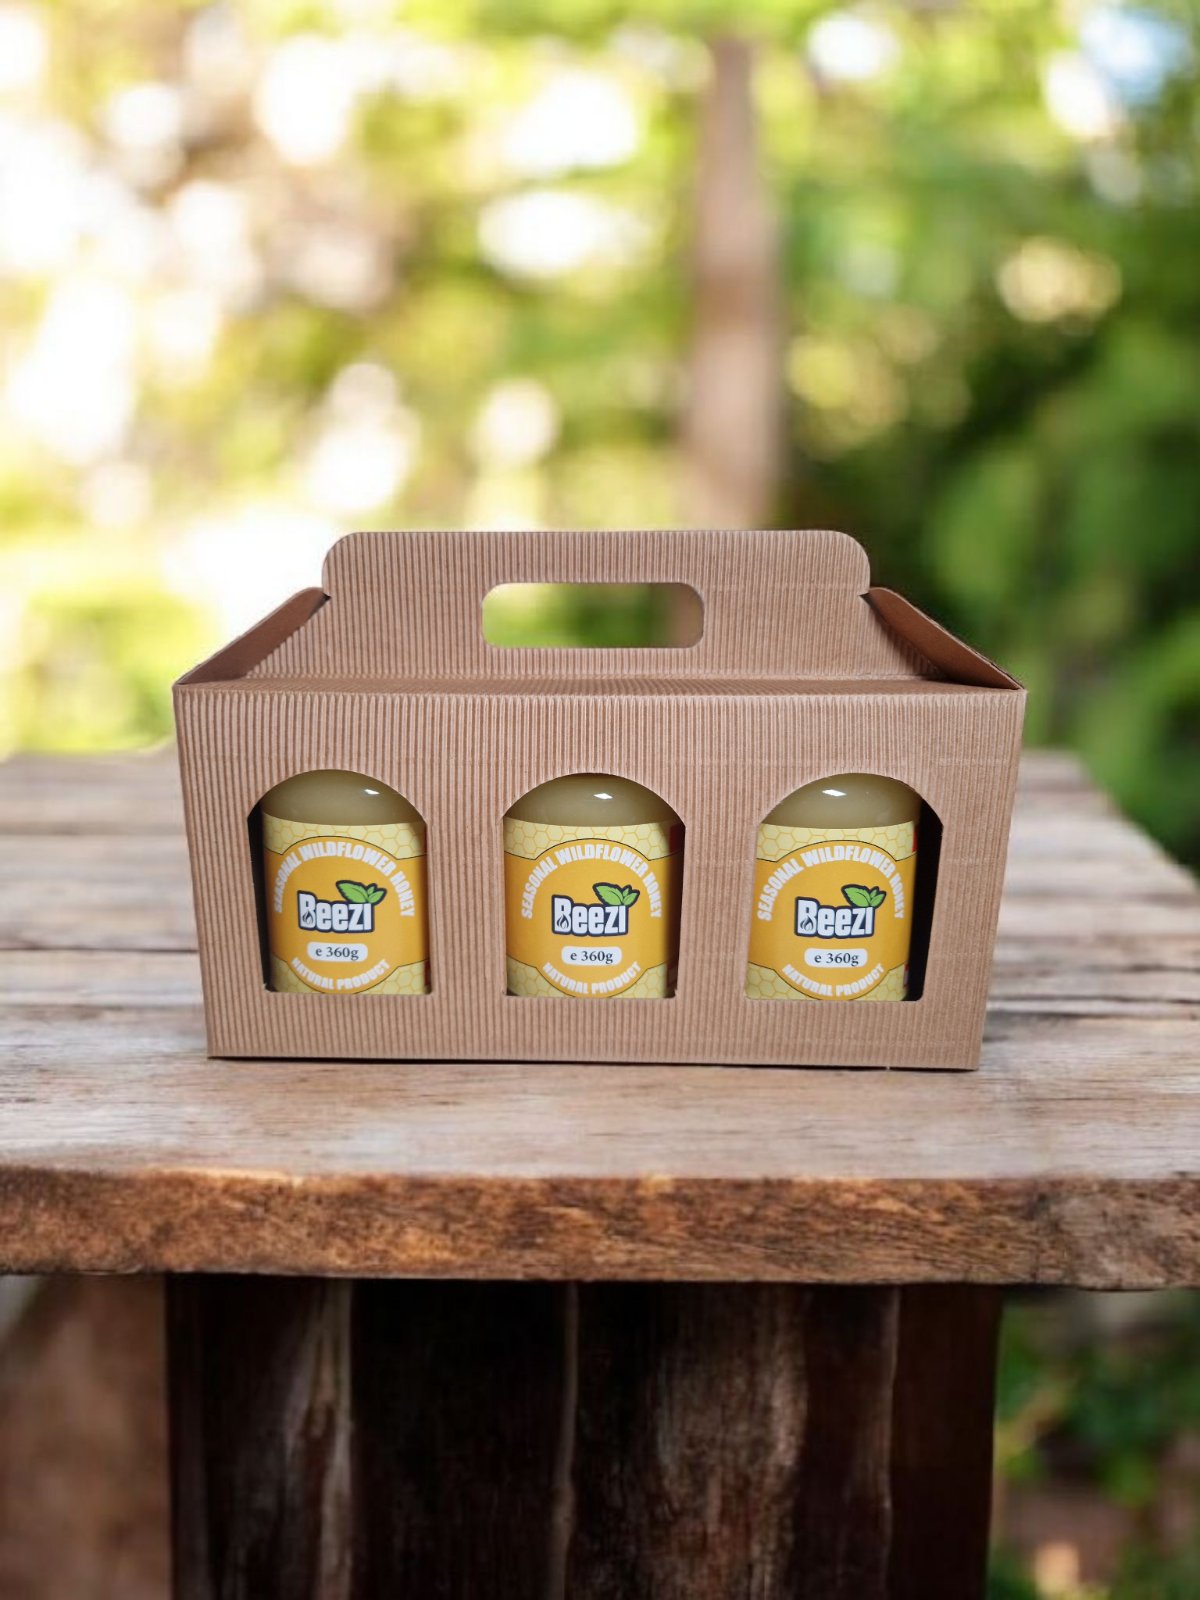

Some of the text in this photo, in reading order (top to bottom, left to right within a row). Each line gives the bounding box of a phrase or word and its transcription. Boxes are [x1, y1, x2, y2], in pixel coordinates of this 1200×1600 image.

[299, 841, 397, 877] WILDFLOWER
[389, 871, 415, 917] HONEY
[521, 843, 662, 919] SEASONAL WILDFLOWER HONEY
[757, 845, 905, 921] SEASONAL WILDFLOWER HONEY
[326, 946, 359, 961] 360g
[581, 950, 614, 964] 360g
[826, 952, 859, 967] 360g
[291, 957, 390, 990] NATURAL PRODUCT
[543, 961, 641, 994] NATURAL PRODUCT
[782, 962, 885, 997] NATURAL PRODUCT
